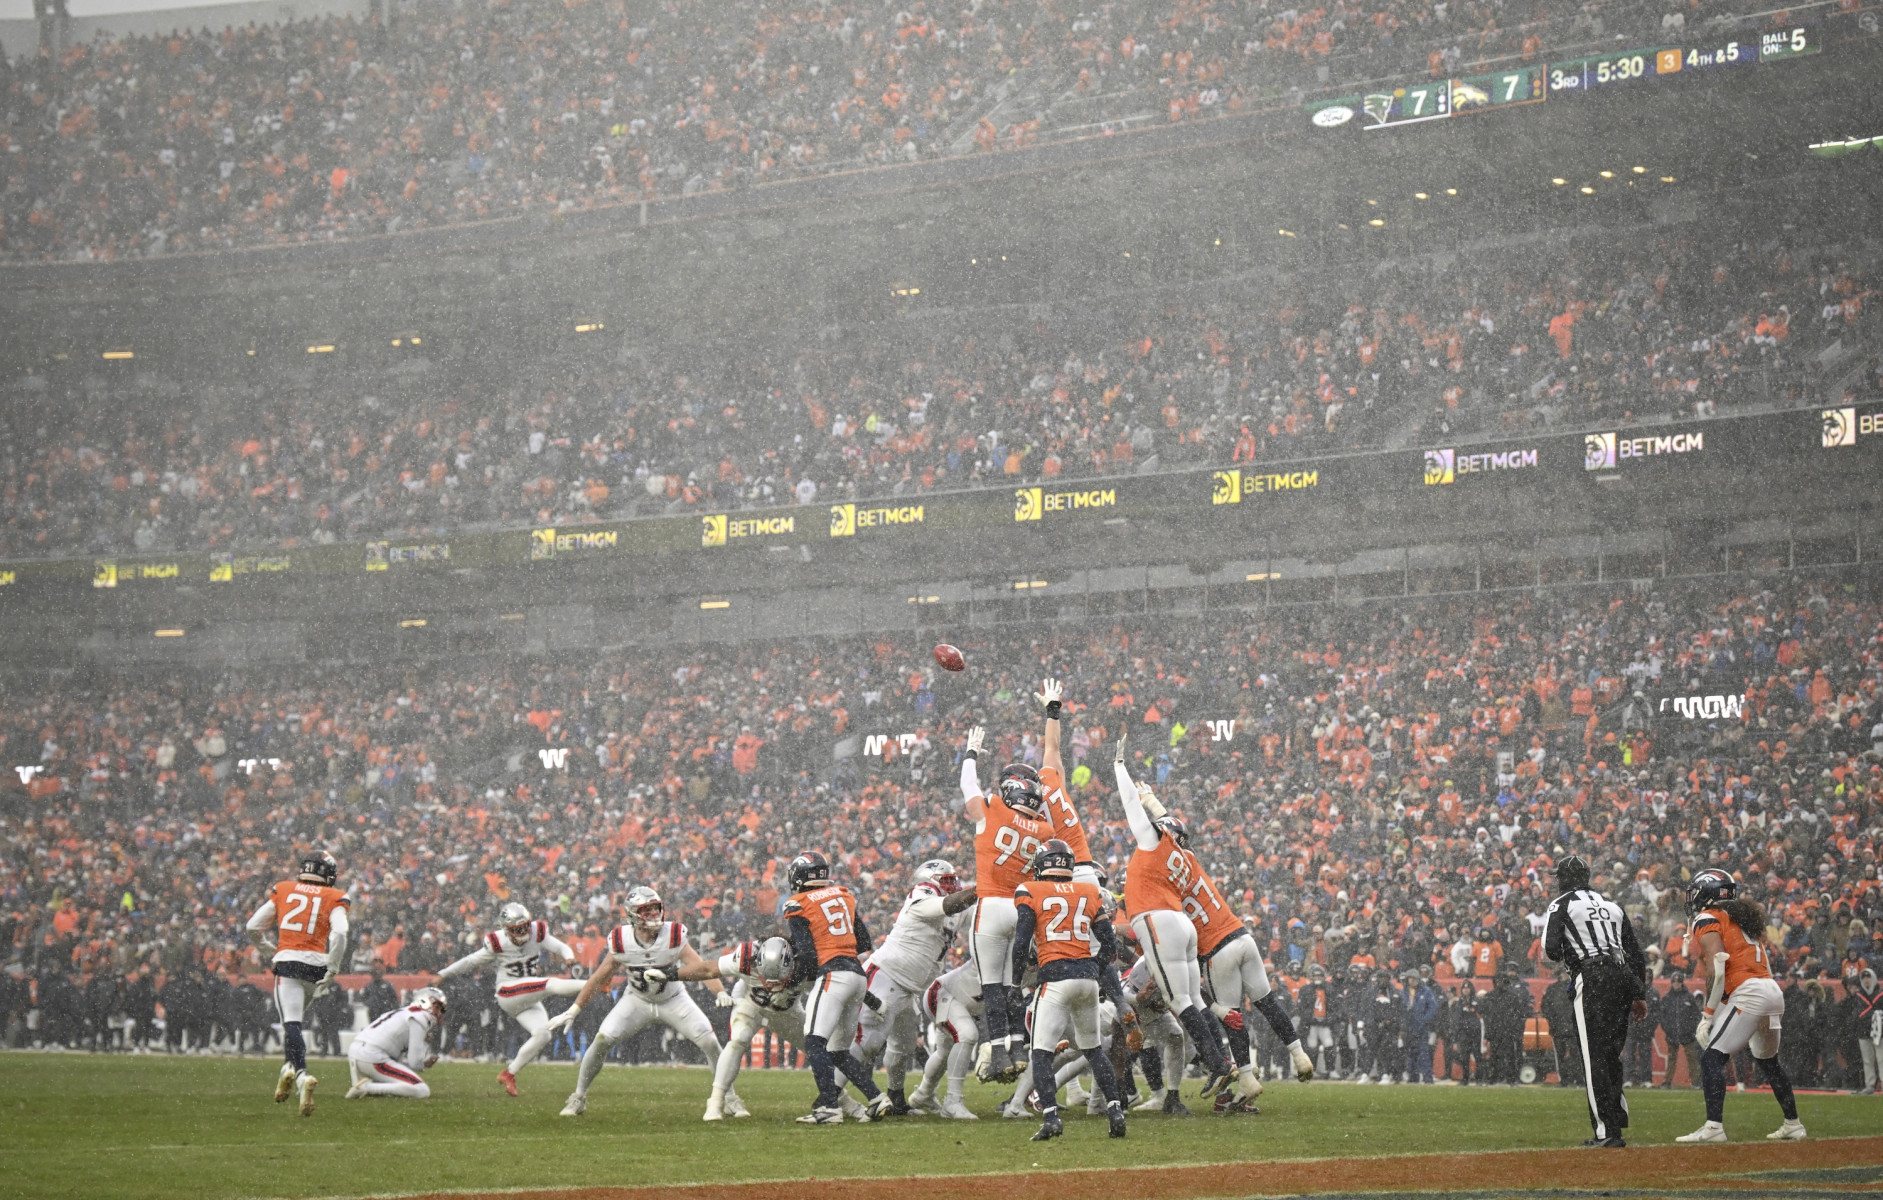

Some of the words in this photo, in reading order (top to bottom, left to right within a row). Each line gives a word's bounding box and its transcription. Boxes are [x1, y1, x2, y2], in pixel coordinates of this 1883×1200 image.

[1763, 32, 1788, 45] BALL
[1791, 28, 1806, 51] 5
[1686, 48, 1713, 67] 4TH
[1763, 44, 1782, 55] ON:
[1597, 56, 1645, 83] 5:30
[1664, 53, 1676, 69] 3
[1503, 75, 1520, 101] 7
[1551, 70, 1579, 90] 3RD
[1411, 90, 1428, 116] 7
[1620, 433, 1703, 457] BETMGM
[1457, 449, 1538, 474] BETMGM
[1244, 471, 1318, 494] BETMGM
[1044, 489, 1116, 511] BETMGM
[857, 505, 924, 527] BETMGM
[729, 516, 795, 537] BETMGM
[556, 531, 618, 550] BETMGM
[1029, 798, 1039, 809] 99
[1012, 814, 1039, 834] ALLEN
[993, 825, 1041, 876] 99
[305, 863, 315, 873] 21
[1055, 857, 1067, 867] 26
[819, 869, 828, 878] 51
[295, 883, 322, 894] MOSS
[1054, 883, 1075, 893] KEY
[1182, 875, 1222, 926] 97
[280, 893, 322, 934] 21
[820, 896, 854, 936] 51
[1042, 896, 1091, 942] 26
[1586, 907, 1610, 920] 20
[1481, 947, 1490, 963] 2
